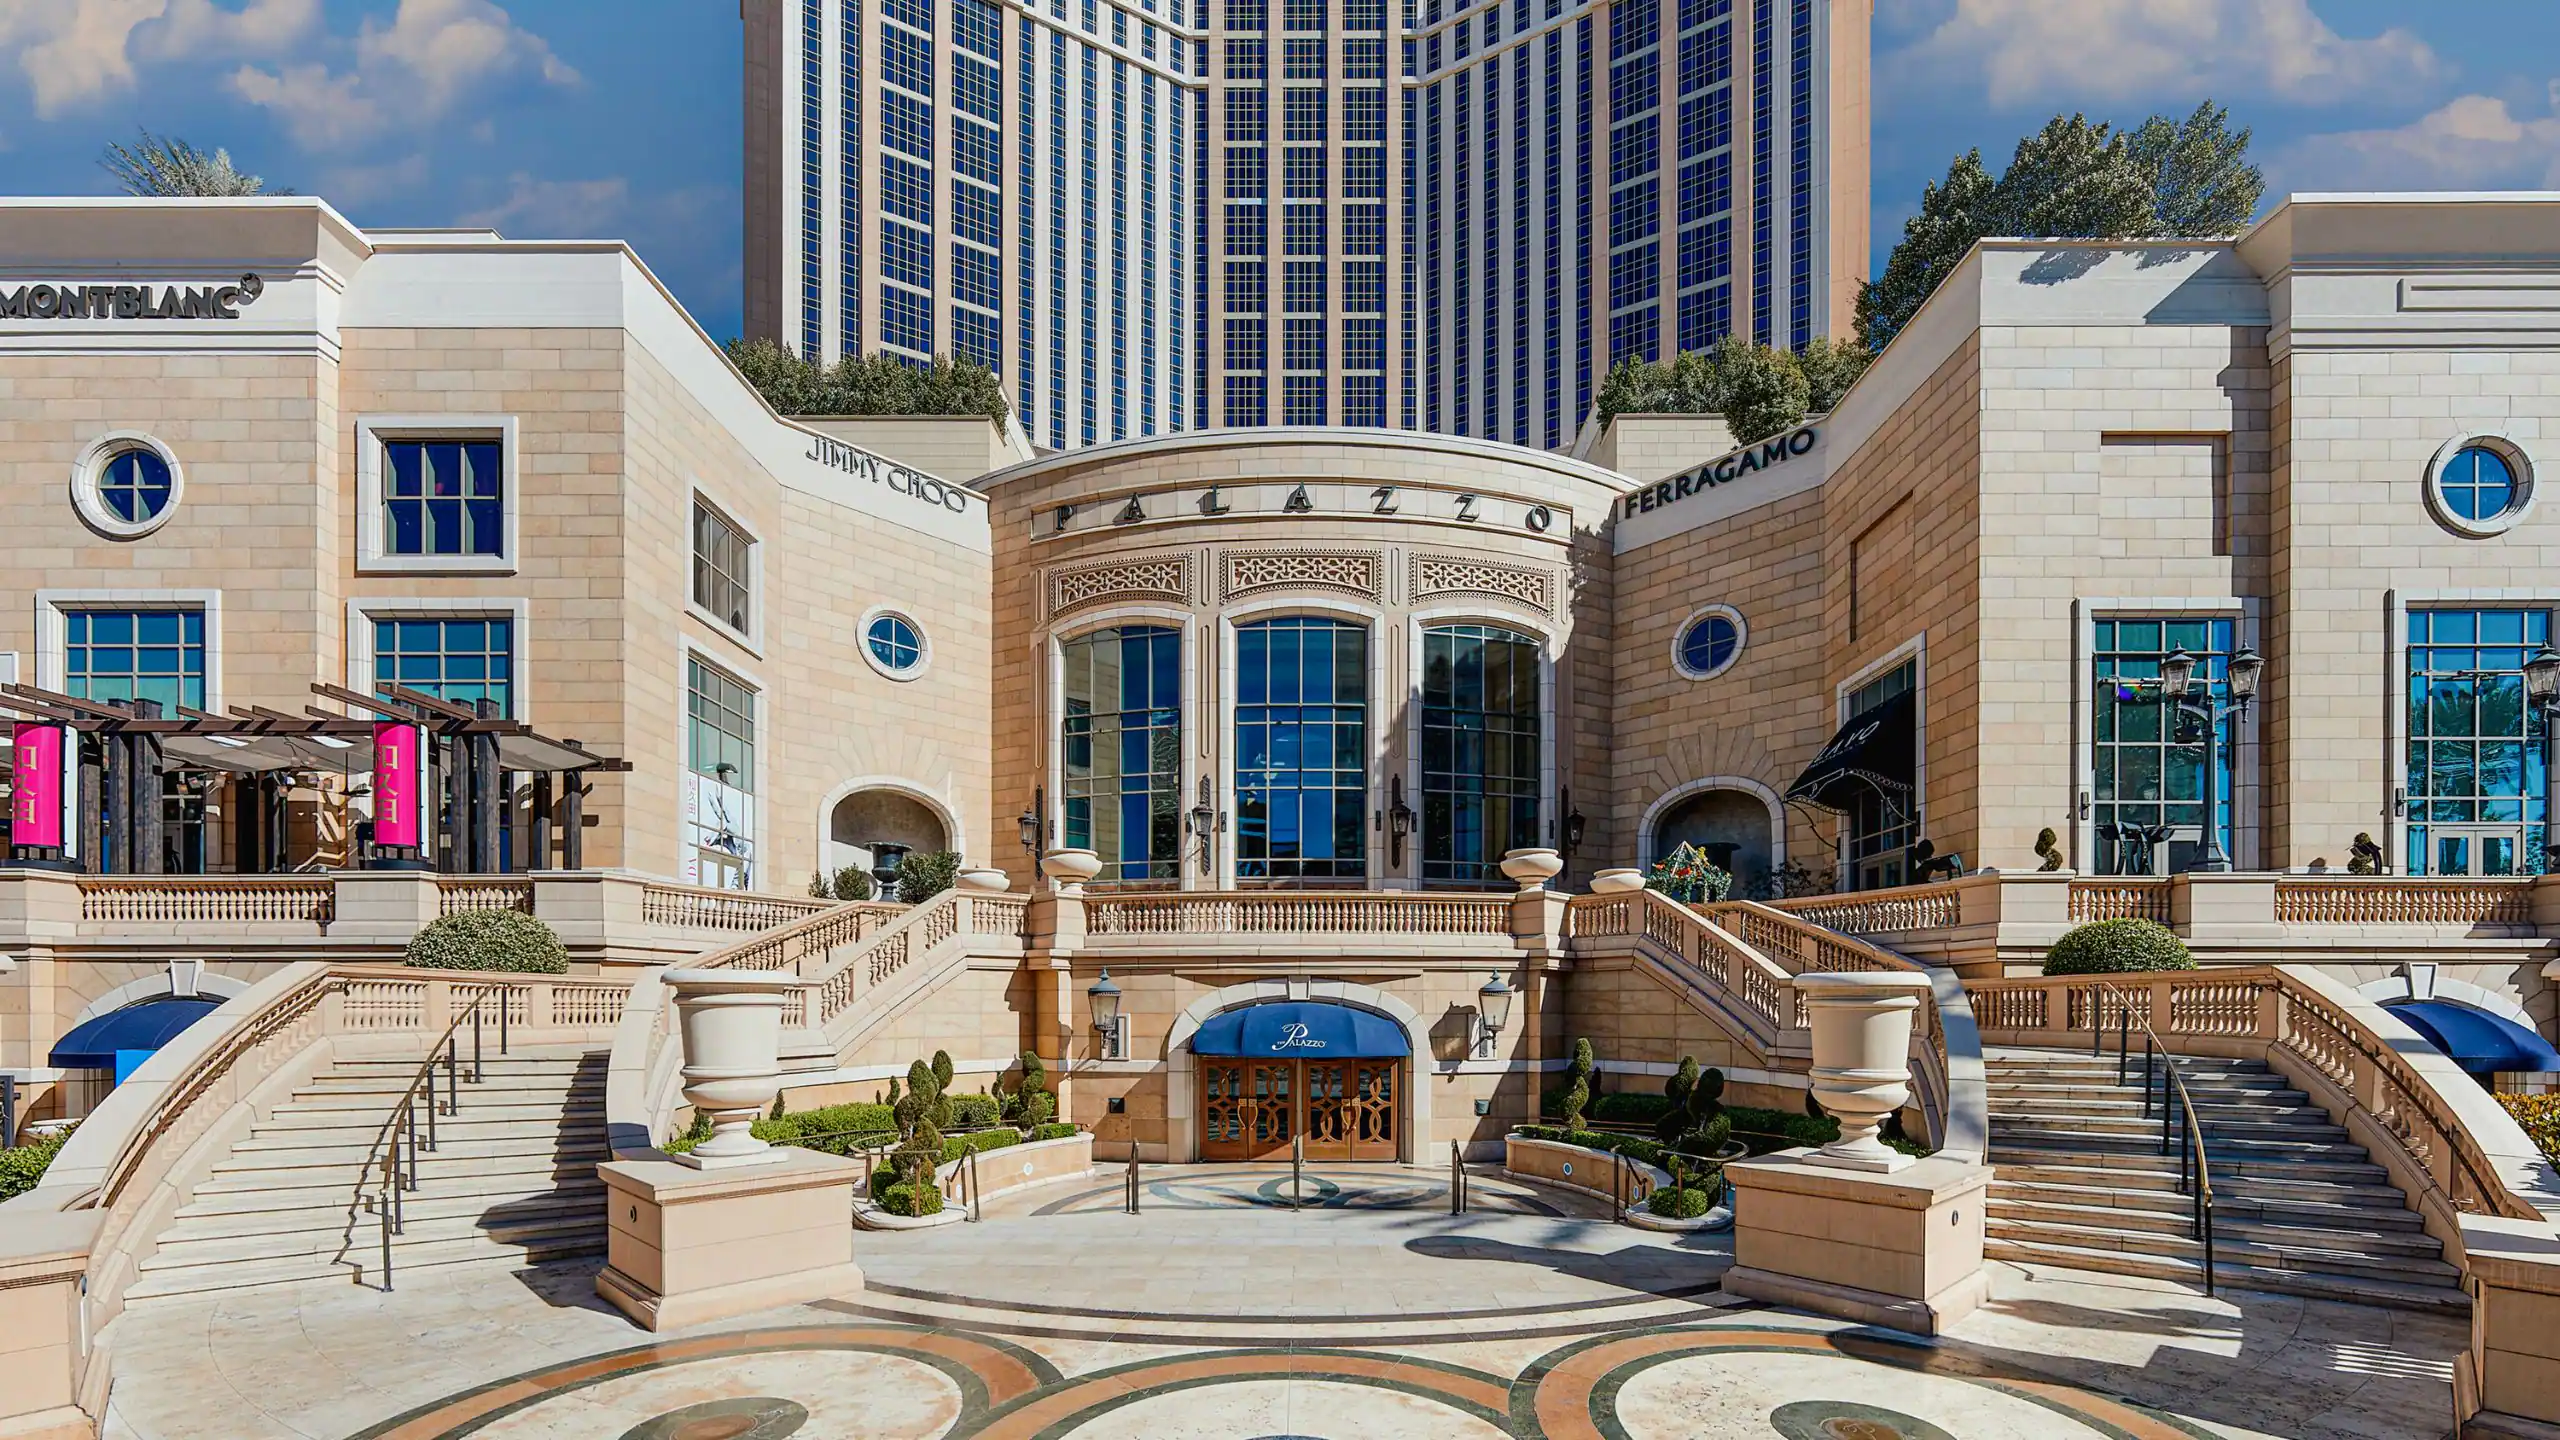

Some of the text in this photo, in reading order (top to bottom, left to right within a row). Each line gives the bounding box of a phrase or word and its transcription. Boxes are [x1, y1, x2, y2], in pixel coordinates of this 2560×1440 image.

[0, 284, 240, 319] MONTBLANC
[805, 436, 967, 513] JIMMY CHOO
[1625, 428, 1815, 519] FERRAGAMO
[1056, 481, 1551, 534] PALAZZO
[1813, 720, 1880, 764] LAVO
